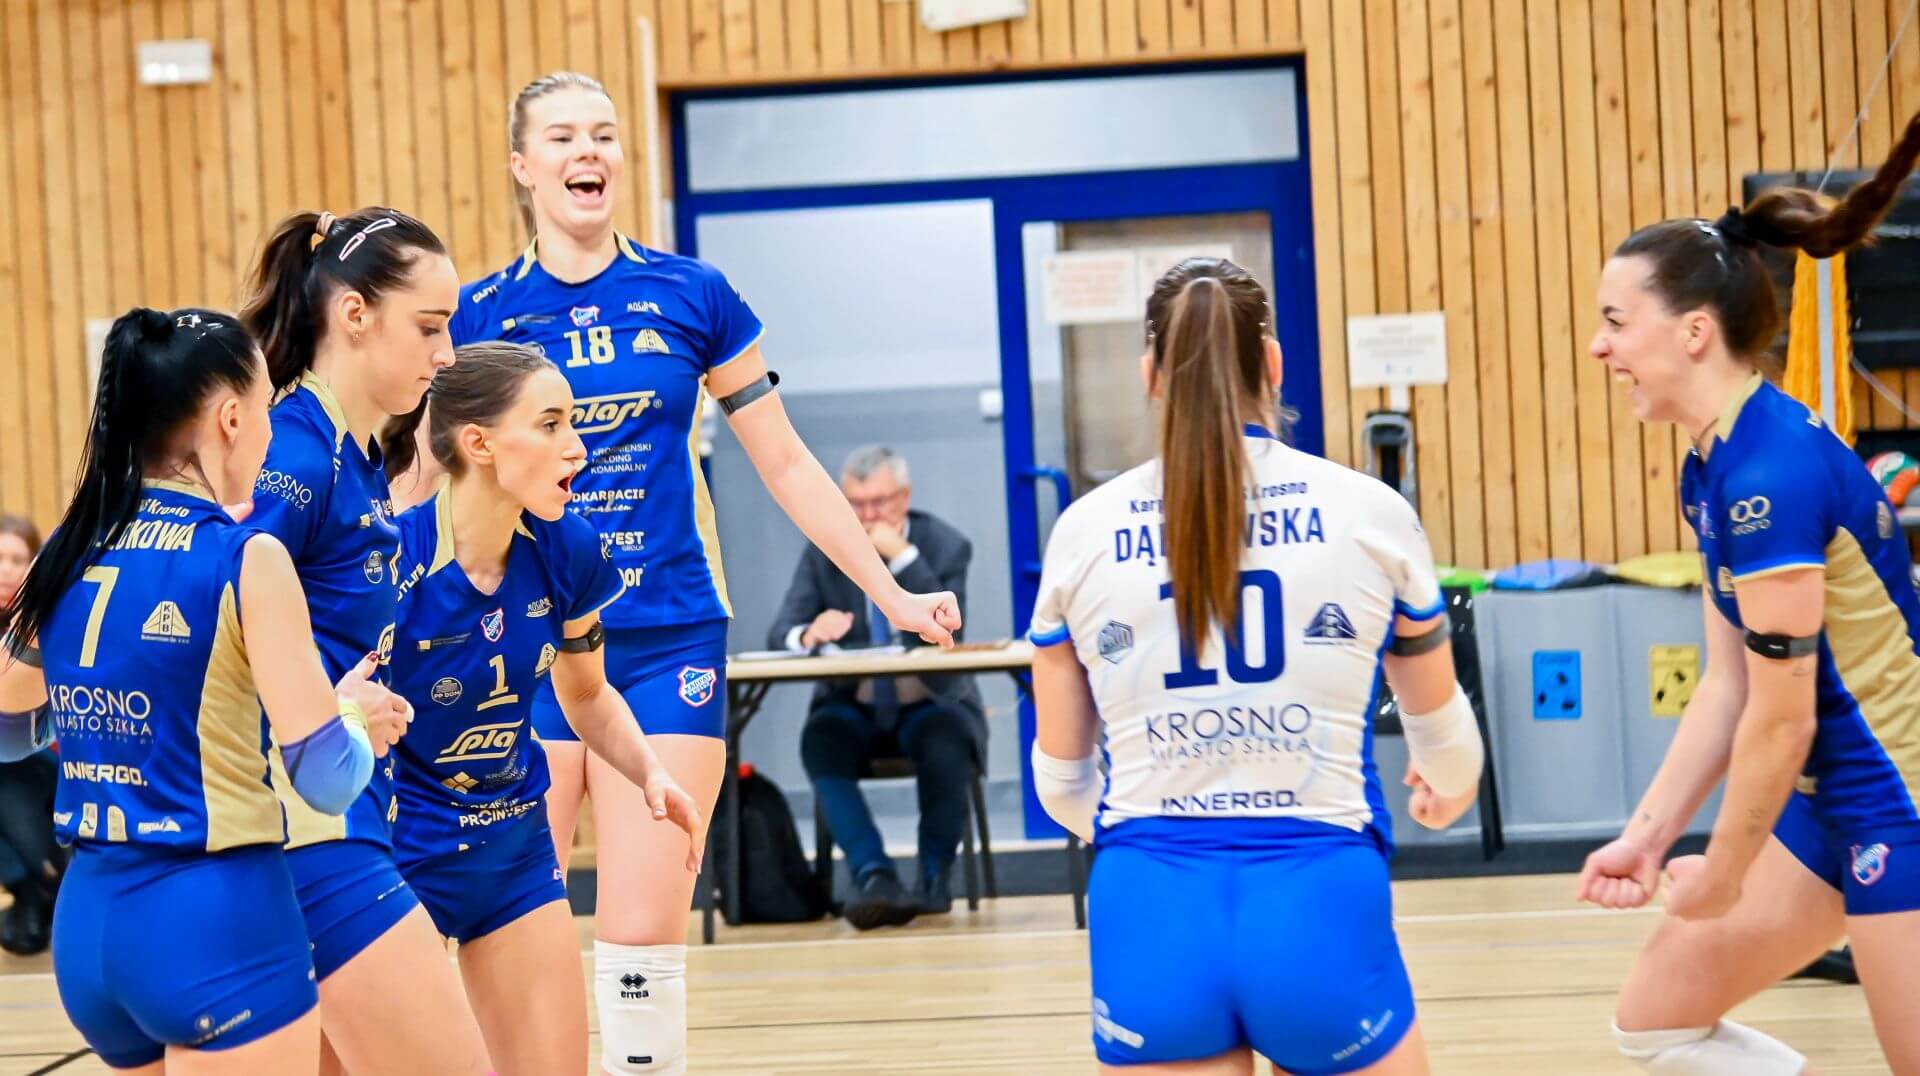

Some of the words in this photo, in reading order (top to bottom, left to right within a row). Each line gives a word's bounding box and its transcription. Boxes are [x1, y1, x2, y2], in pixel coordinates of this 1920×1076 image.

[563, 325, 615, 368] 18
[257, 468, 313, 504] ROSNO
[590, 462, 648, 475] KOMUNALNY
[79, 565, 120, 668] 7
[1159, 569, 1286, 690] 10
[488, 653, 510, 697] 1
[49, 684, 152, 720] KROSNO
[106, 717, 153, 736] SZKŁA
[1145, 703, 1312, 744] KROSNO
